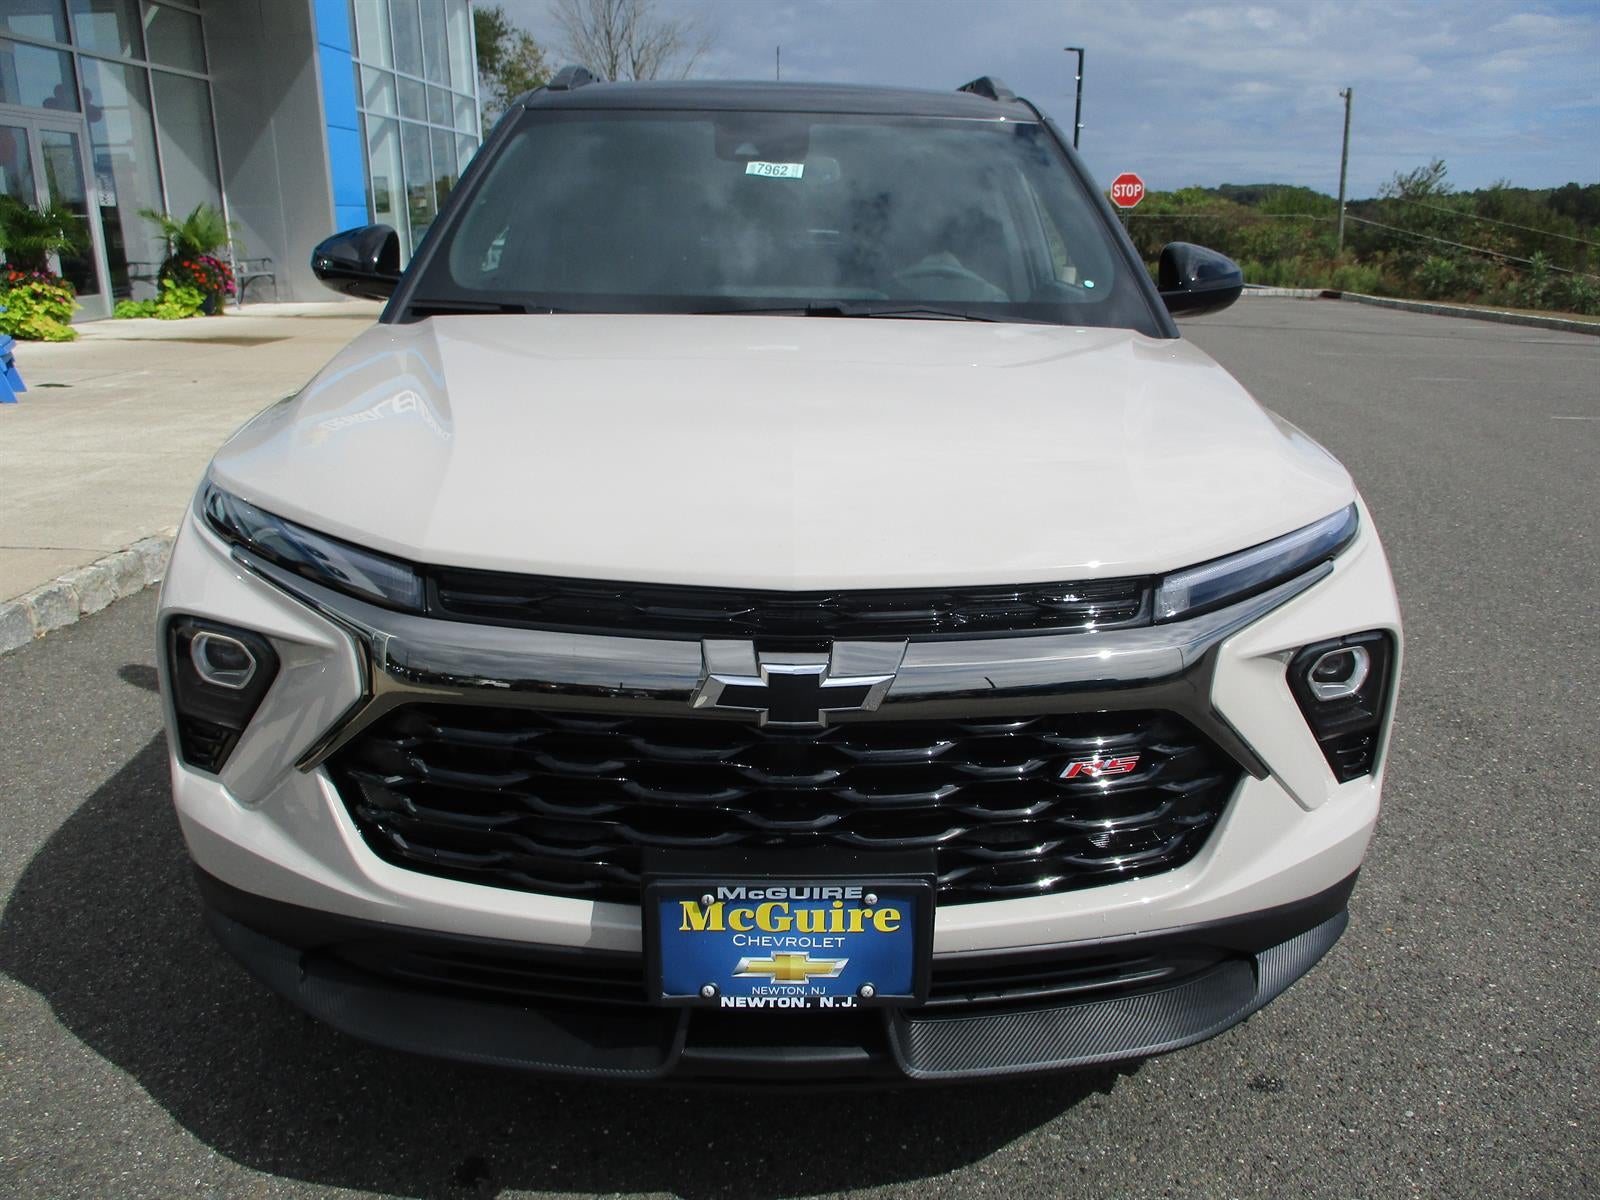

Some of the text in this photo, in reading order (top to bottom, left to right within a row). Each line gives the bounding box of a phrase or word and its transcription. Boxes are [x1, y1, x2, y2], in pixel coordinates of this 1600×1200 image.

[757, 163, 788, 176] 7962
[1113, 184, 1142, 197] STOP
[1060, 756, 1140, 778] RS
[717, 887, 863, 900] McGUIRE
[679, 901, 901, 932] McGuire
[732, 934, 846, 948] CHEVROLET
[751, 987, 826, 995] NEWTON, NJ
[720, 997, 858, 1008] NEWTON, N.J.
